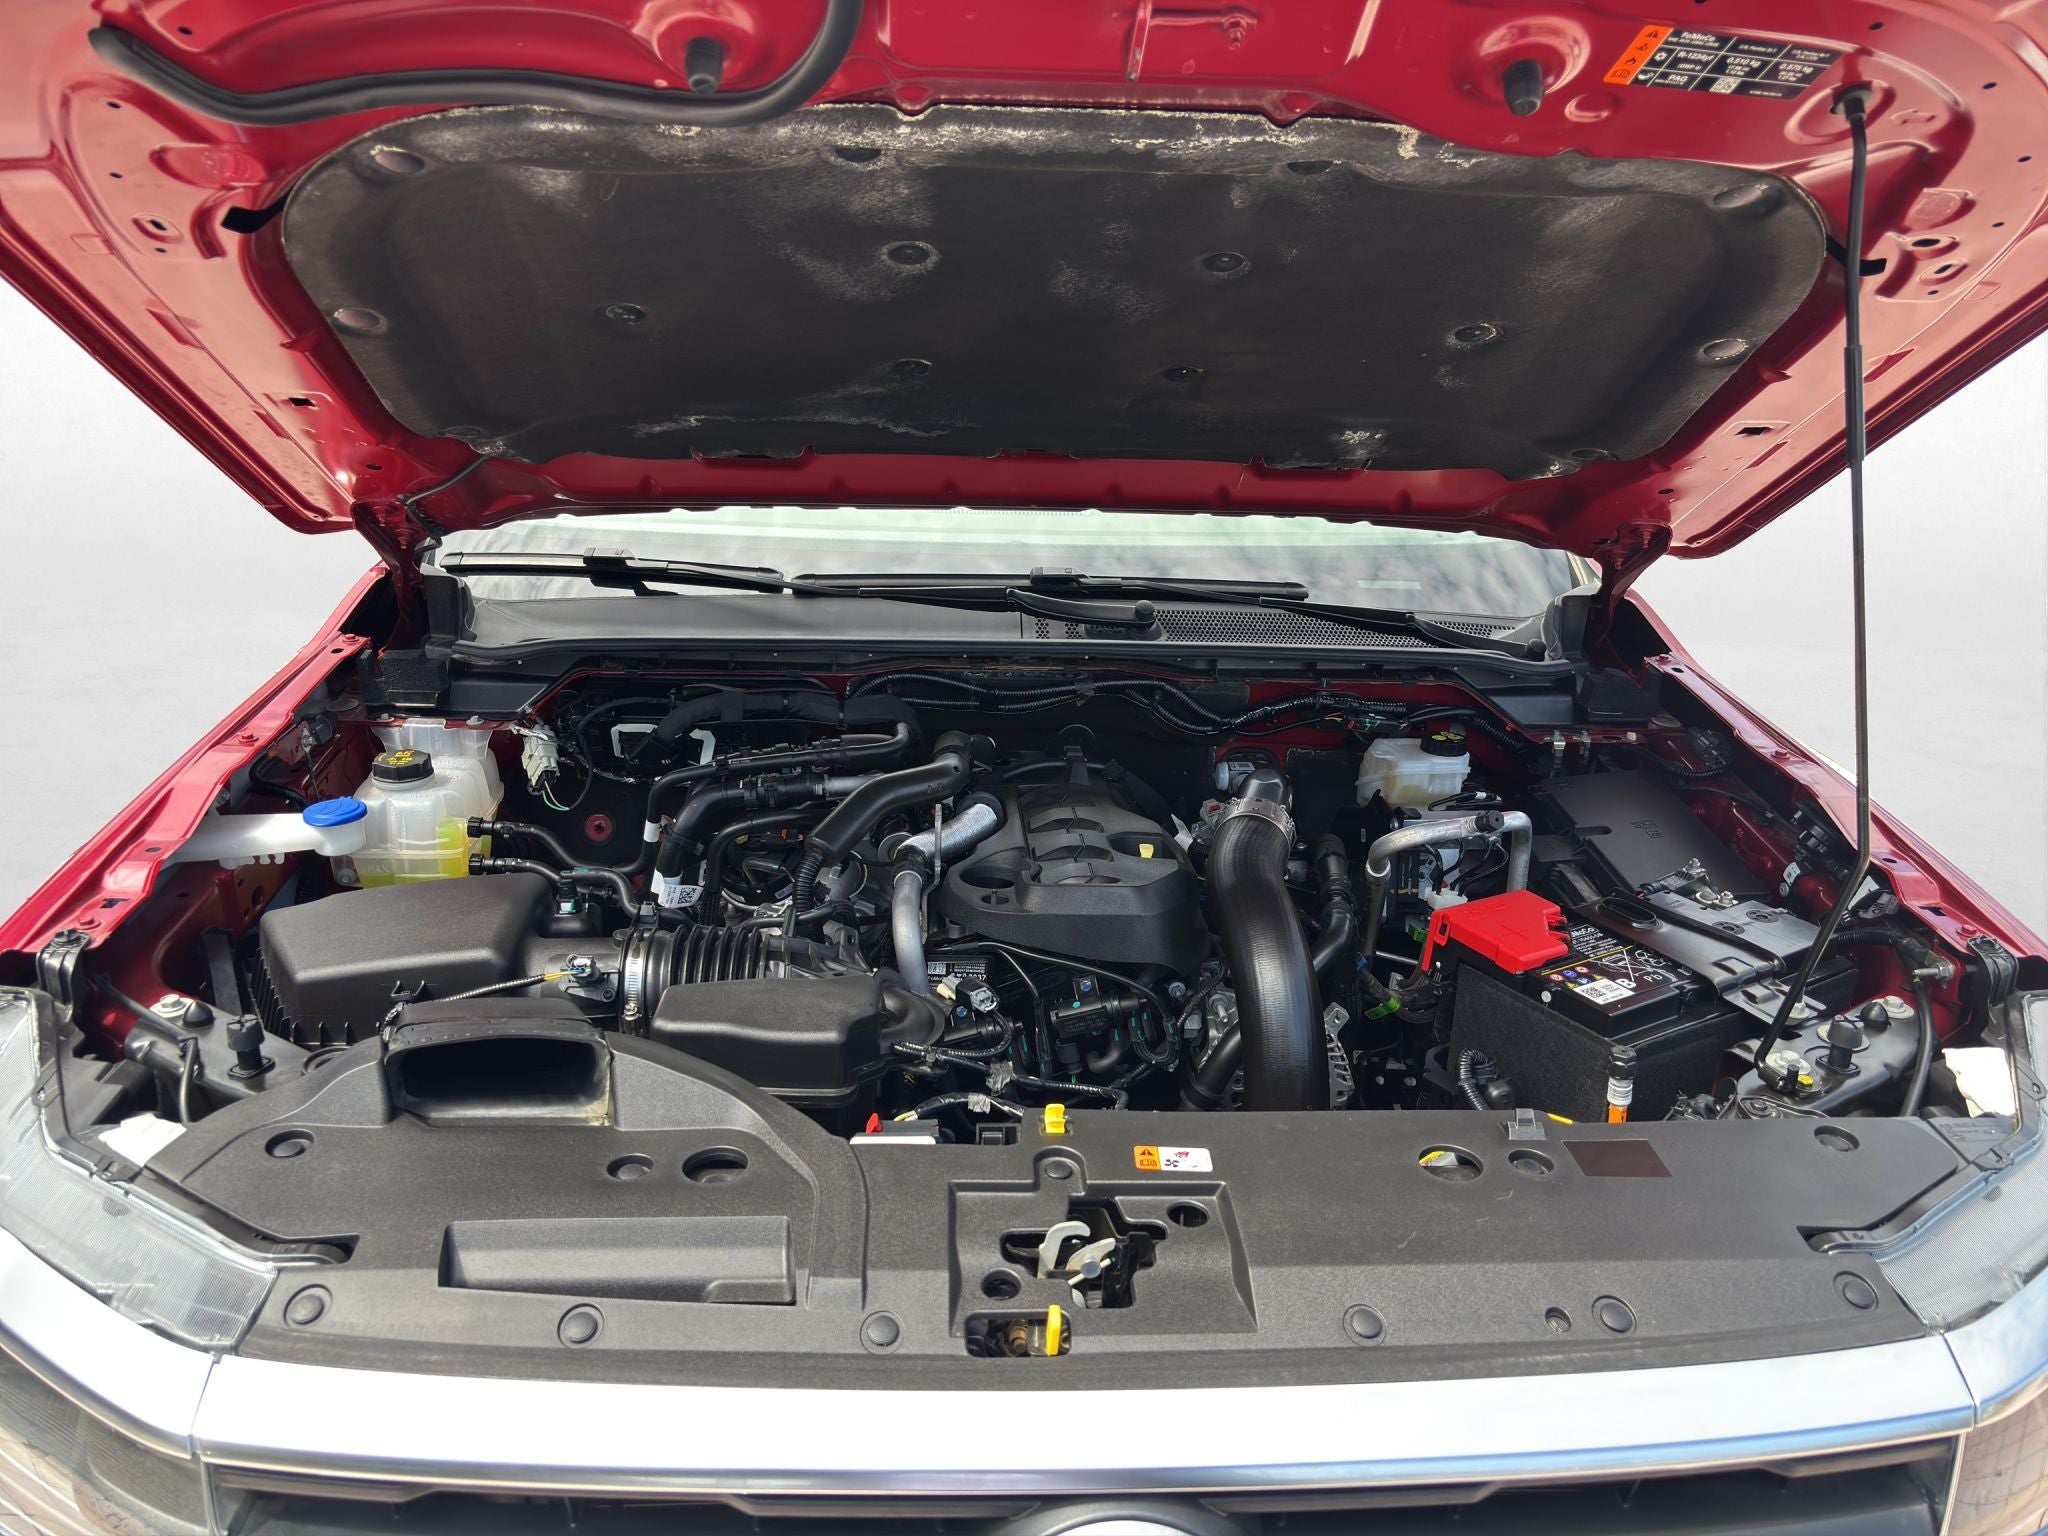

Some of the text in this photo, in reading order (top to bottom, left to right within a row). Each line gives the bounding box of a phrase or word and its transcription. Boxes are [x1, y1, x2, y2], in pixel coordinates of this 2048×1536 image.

[1750, 60, 1762, 68] kg
[1802, 65, 1814, 74] kg
[1643, 973, 1664, 983] Pb
